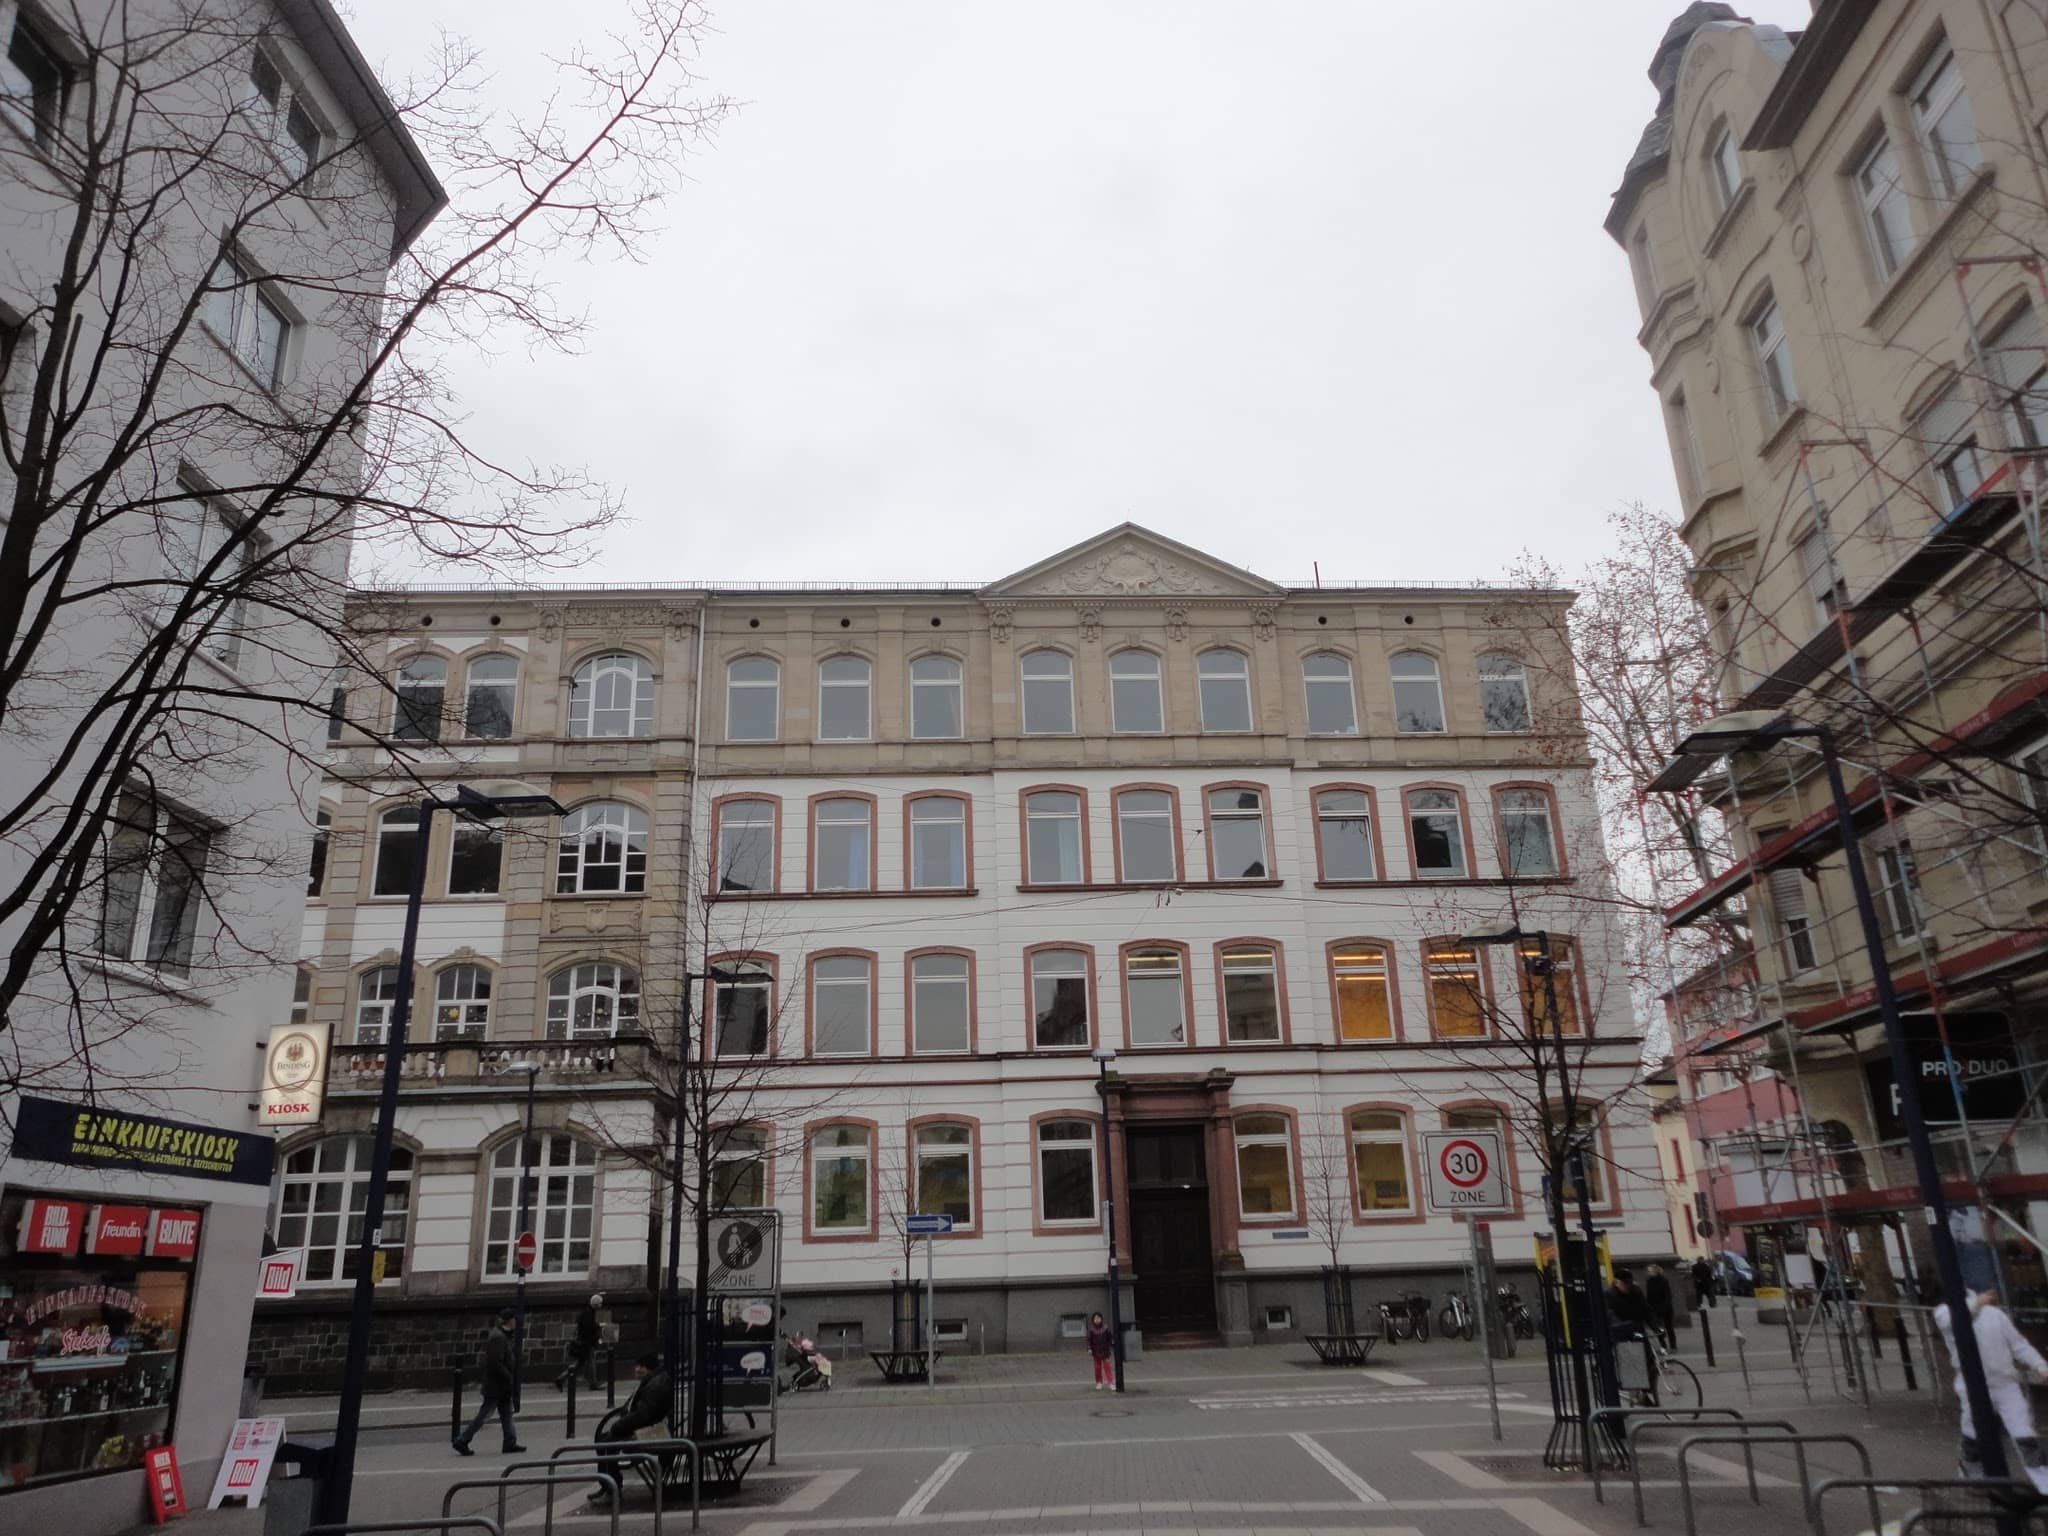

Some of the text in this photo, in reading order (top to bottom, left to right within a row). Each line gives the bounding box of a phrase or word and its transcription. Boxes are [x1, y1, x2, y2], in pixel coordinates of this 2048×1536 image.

[267, 1103, 311, 1115] KIOSK
[74, 1113, 239, 1162] EINKAUFSKIOSK
[1450, 1153, 1478, 1175] 30
[1450, 1190, 1486, 1203] ZONE
[40, 1226, 69, 1248] FUNK
[101, 1219, 141, 1240] freundin
[158, 1219, 197, 1245] BUNTE
[721, 1273, 757, 1287] ZONE
